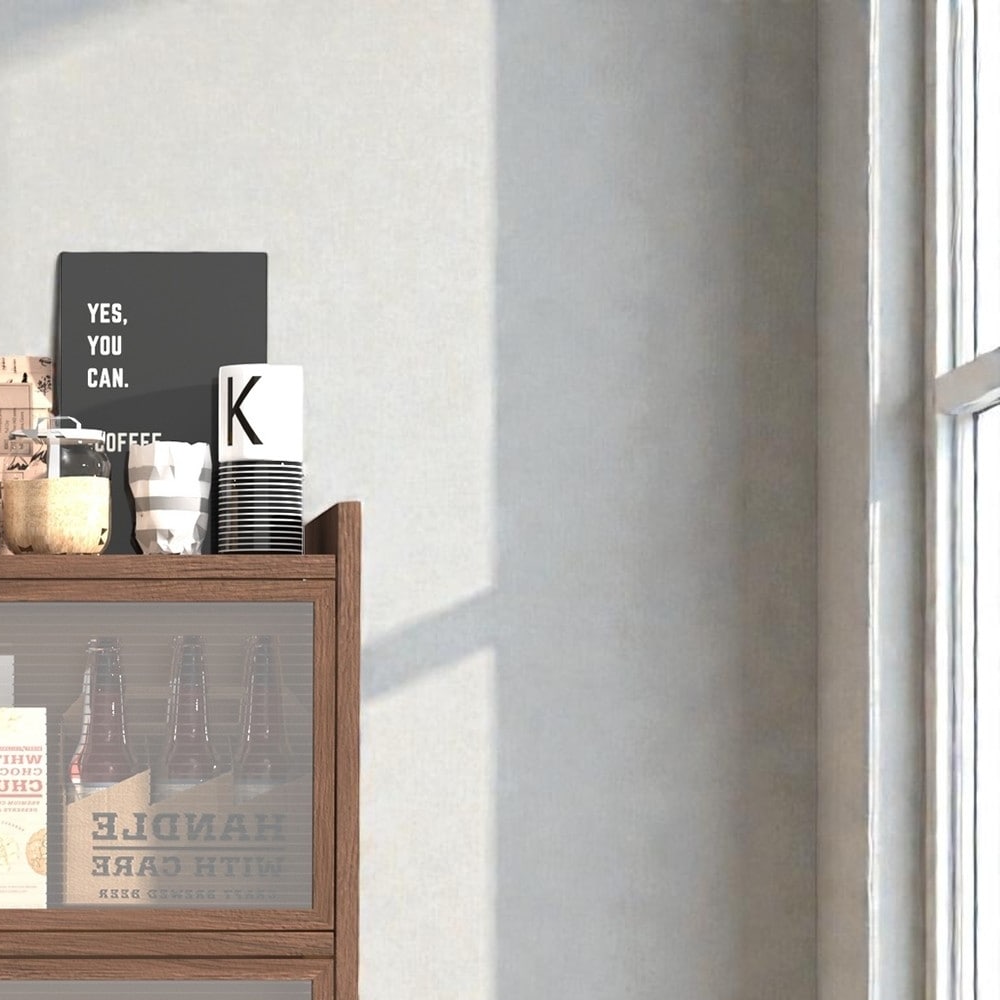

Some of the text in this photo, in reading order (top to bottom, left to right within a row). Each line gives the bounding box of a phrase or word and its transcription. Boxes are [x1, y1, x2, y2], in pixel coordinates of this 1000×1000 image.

[87, 303, 128, 325] YES,
[87, 335, 122, 356] YOU
[87, 367, 129, 388] CAN.
[227, 375, 264, 446] K
